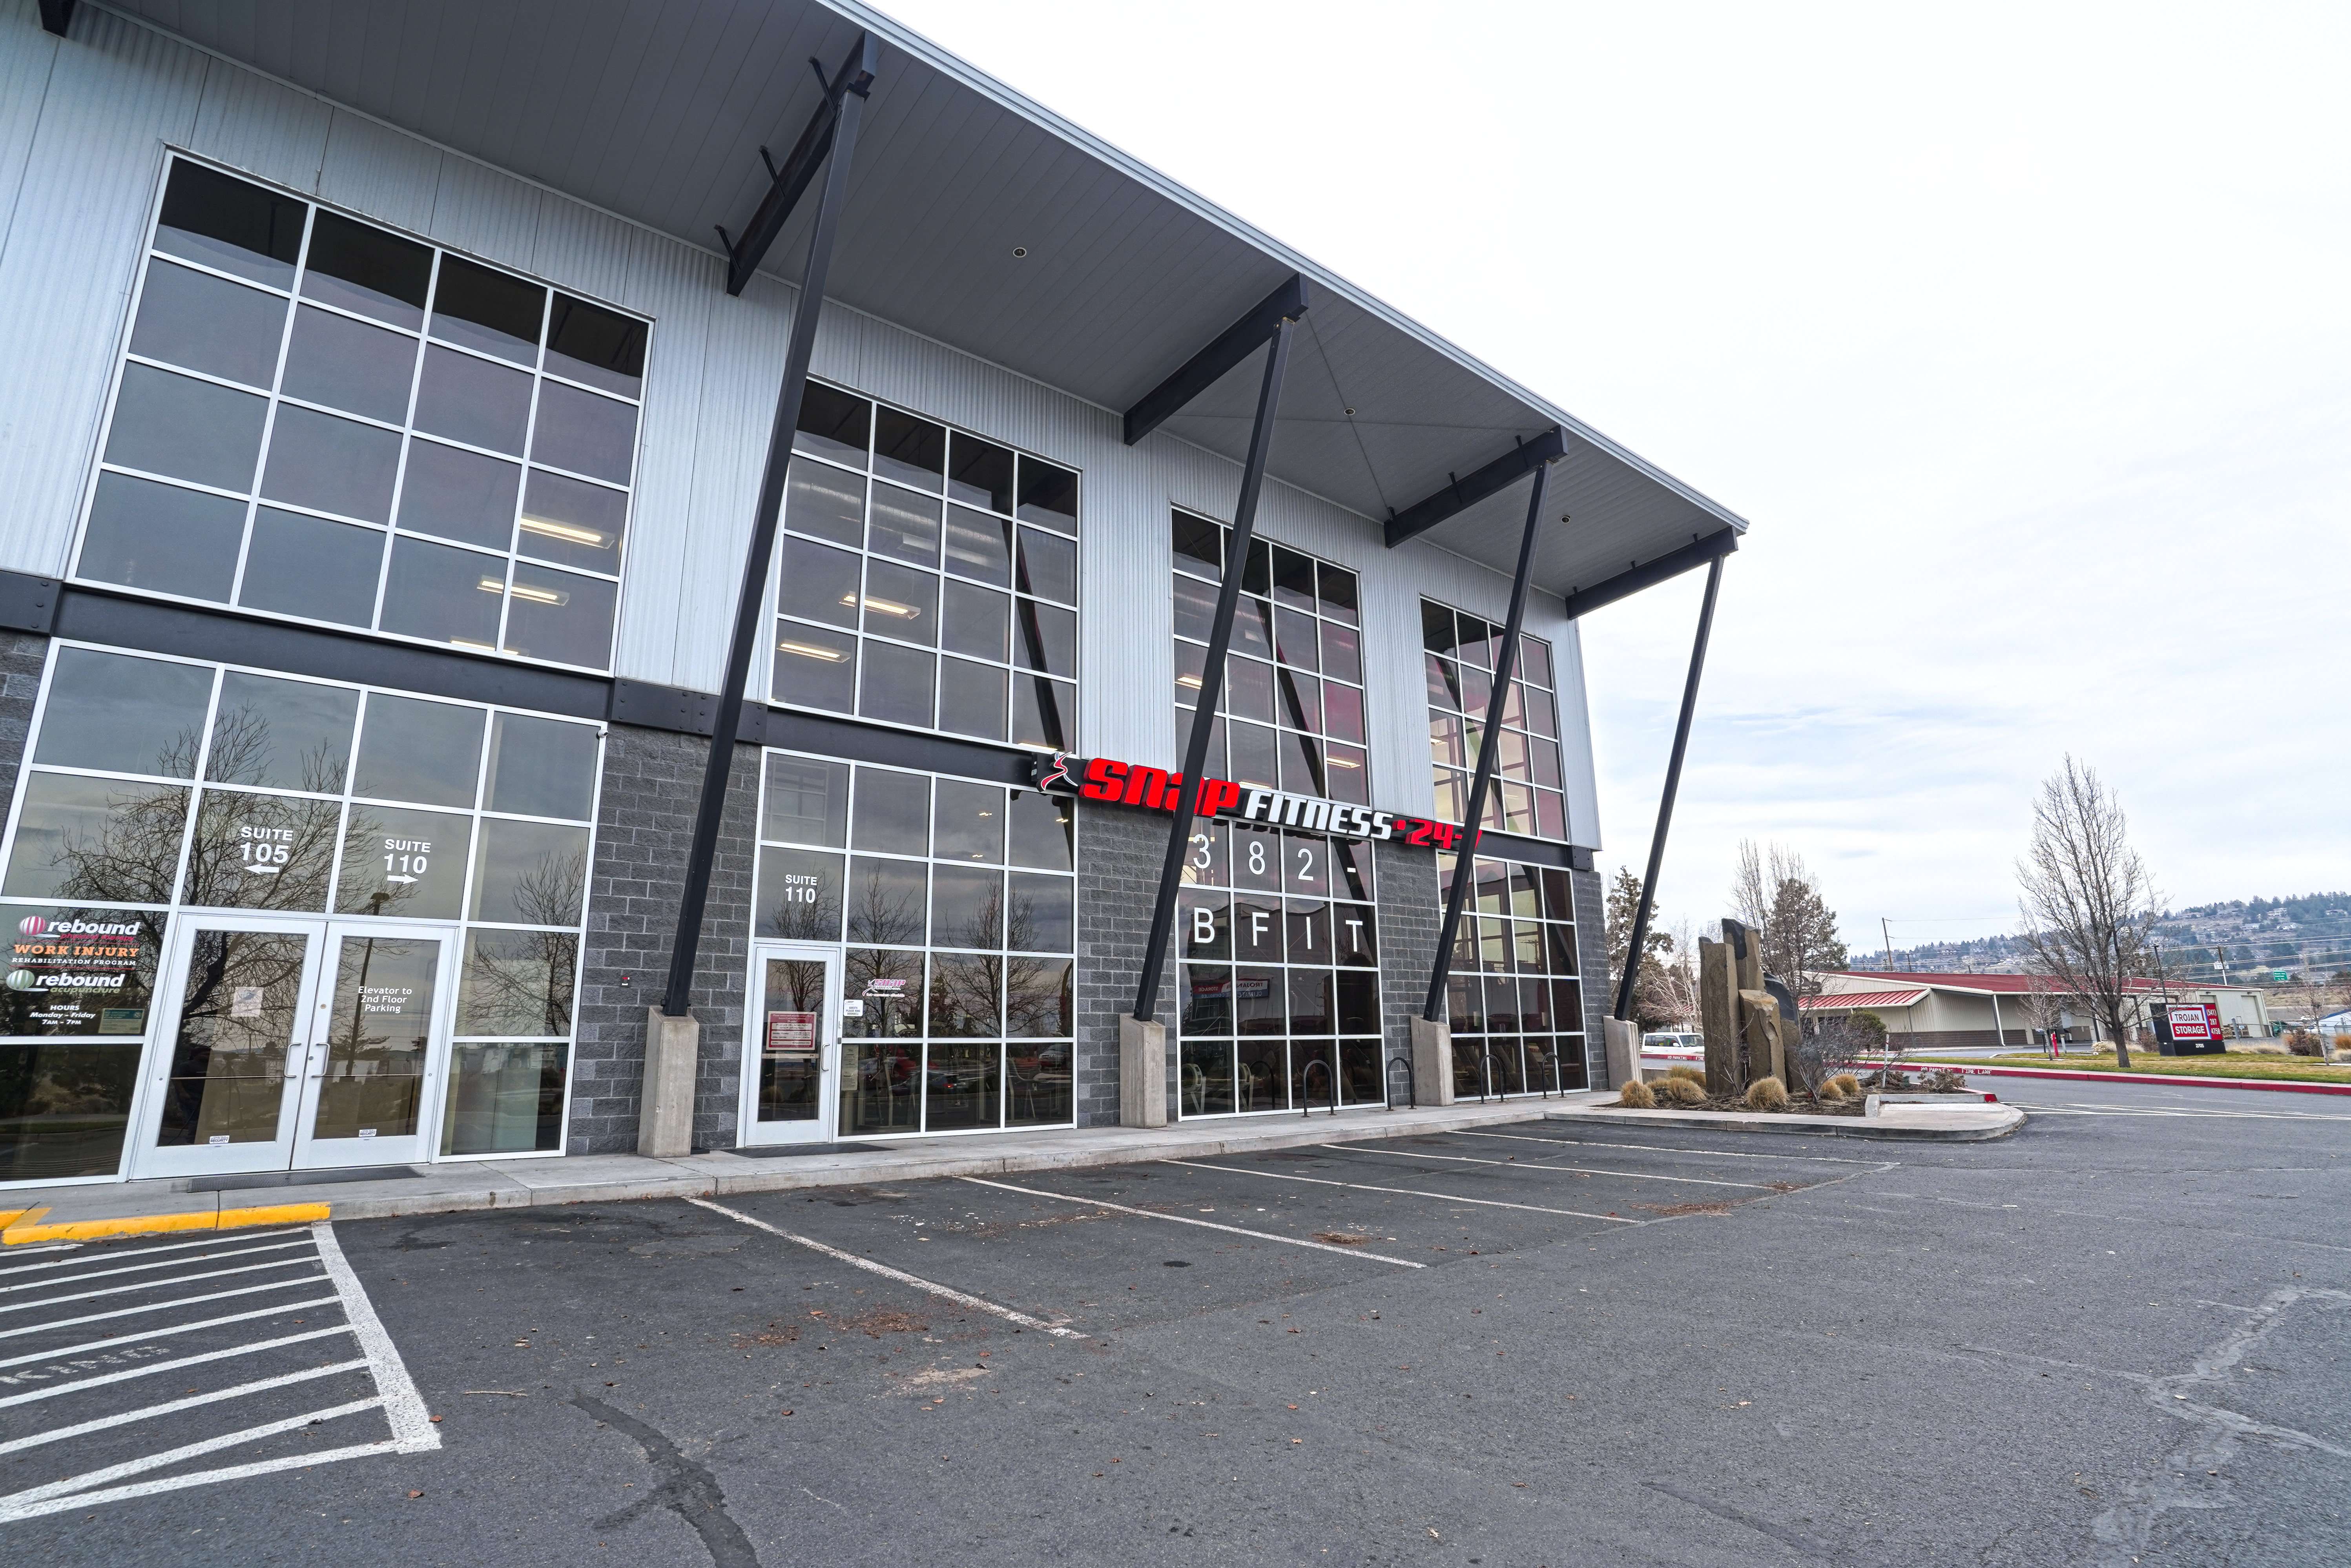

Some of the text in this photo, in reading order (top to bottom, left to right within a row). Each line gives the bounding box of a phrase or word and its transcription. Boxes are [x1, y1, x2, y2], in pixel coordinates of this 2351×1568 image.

[1244, 790, 1393, 840] FITNESS
[241, 826, 294, 841] SUITE
[240, 842, 289, 863] 105
[384, 839, 431, 853] SUITE
[384, 853, 427, 874] 110
[785, 874, 817, 885] SUITE
[786, 886, 816, 903] 110
[47, 919, 140, 935] rebound
[15, 944, 139, 957] WORK INJURY
[36, 973, 125, 986] rebound
[358, 986, 399, 994] Elevator
[365, 1004, 401, 1014] Parking
[2175, 1026, 2205, 1034] STORAGE
